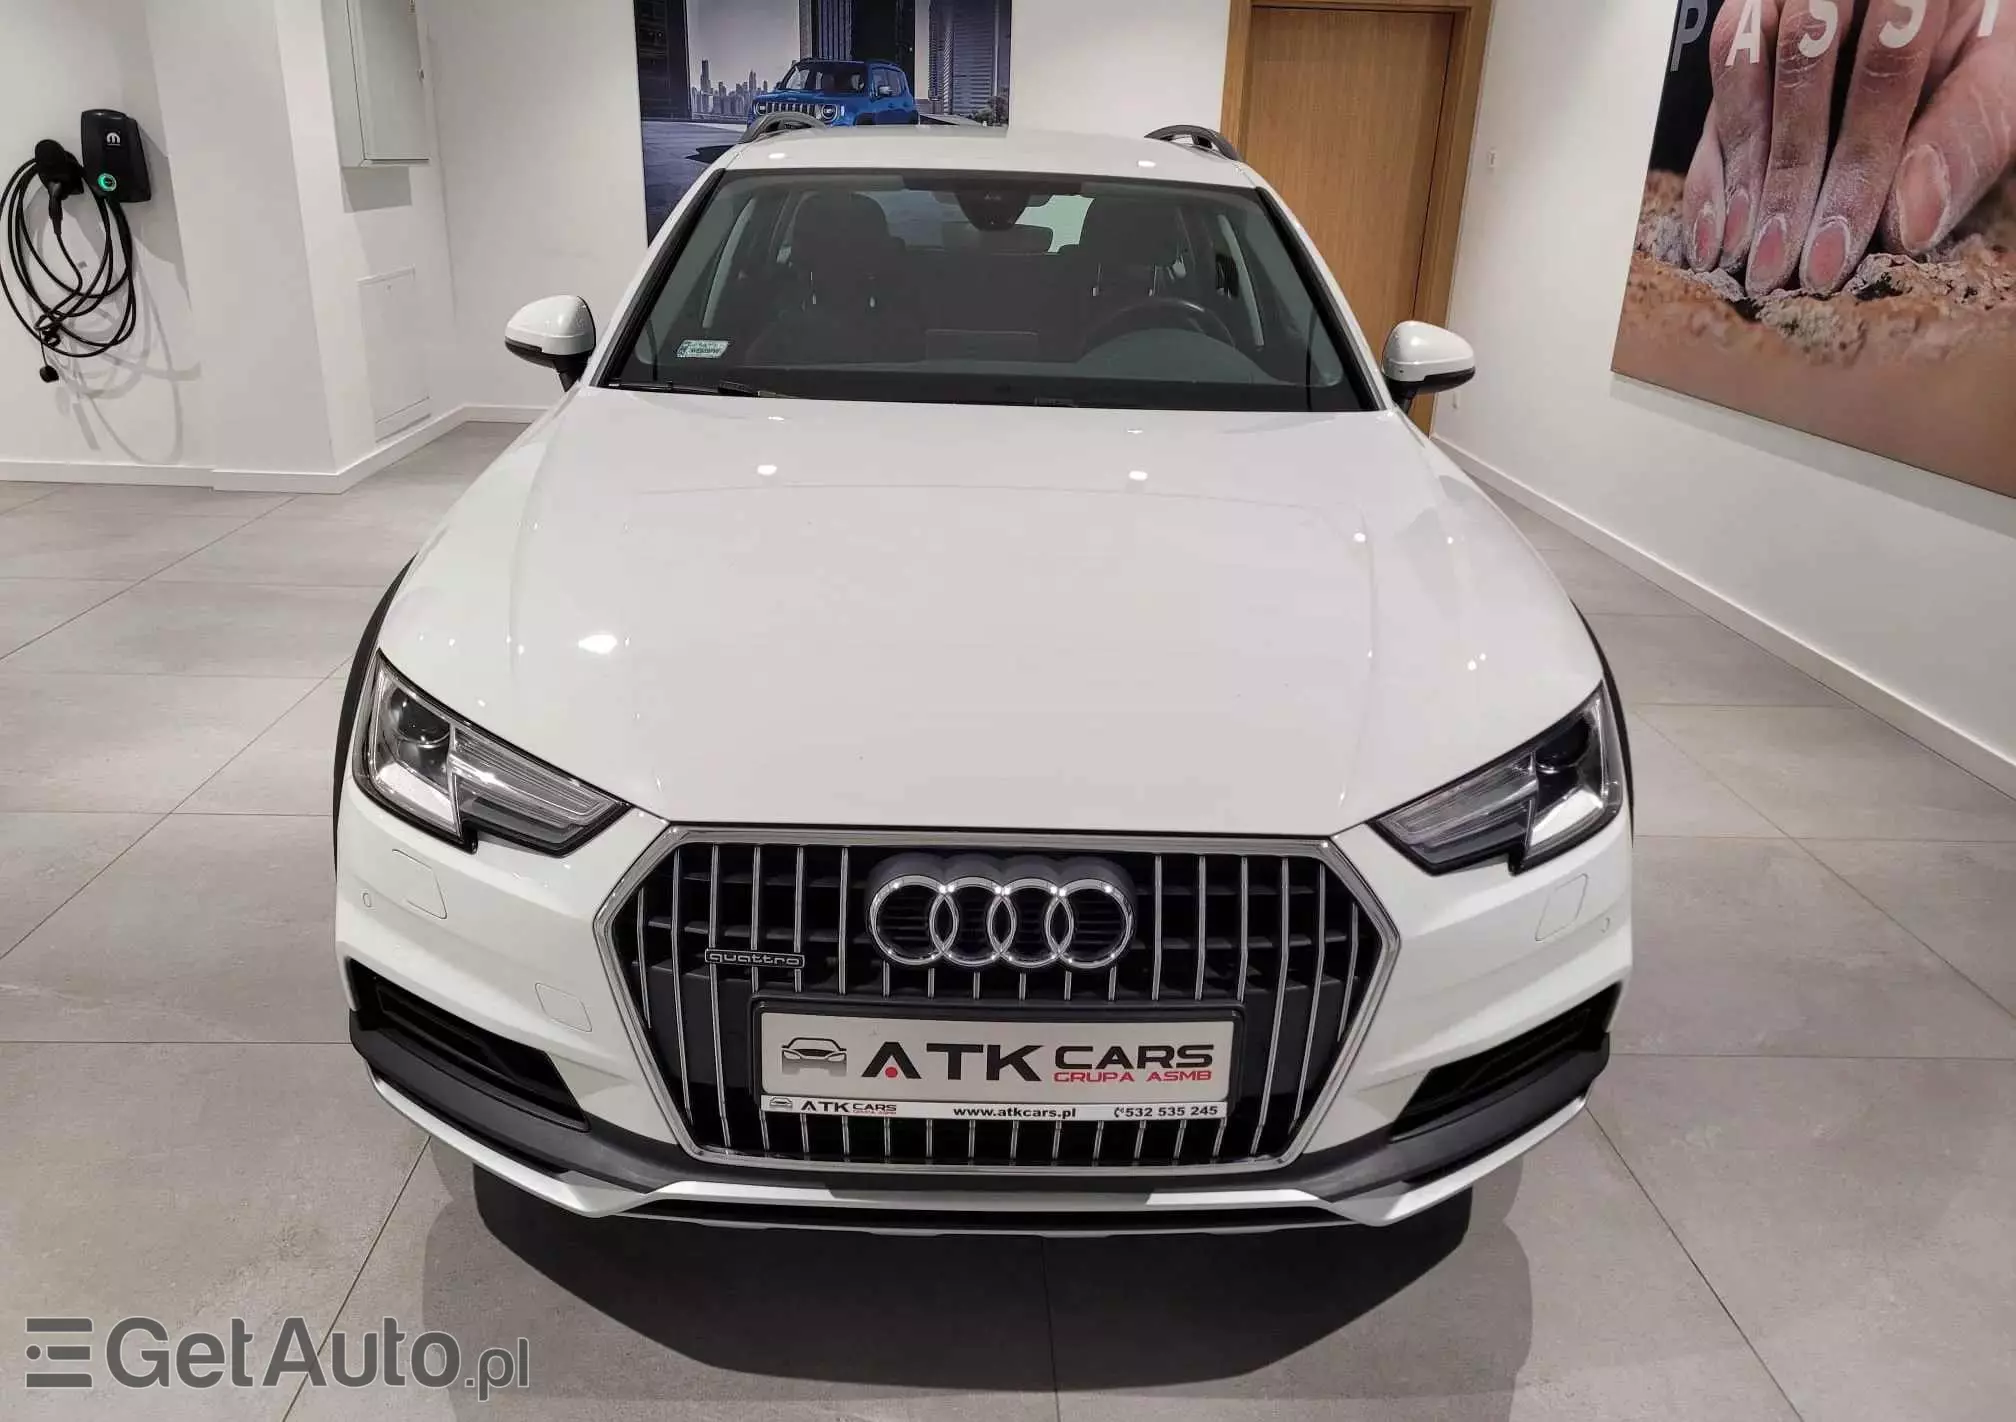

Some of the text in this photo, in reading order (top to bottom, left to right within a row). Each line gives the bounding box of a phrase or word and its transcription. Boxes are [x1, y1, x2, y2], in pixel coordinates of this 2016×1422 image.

[709, 953, 799, 965] quattro
[861, 1041, 1214, 1081] ATK CARS
[1054, 1070, 1212, 1083] GRUPA ASMB
[852, 1103, 897, 1112] CARS
[953, 1107, 1076, 1119] www.atkcars.pl
[1125, 1105, 1218, 1118] 532 535 245
